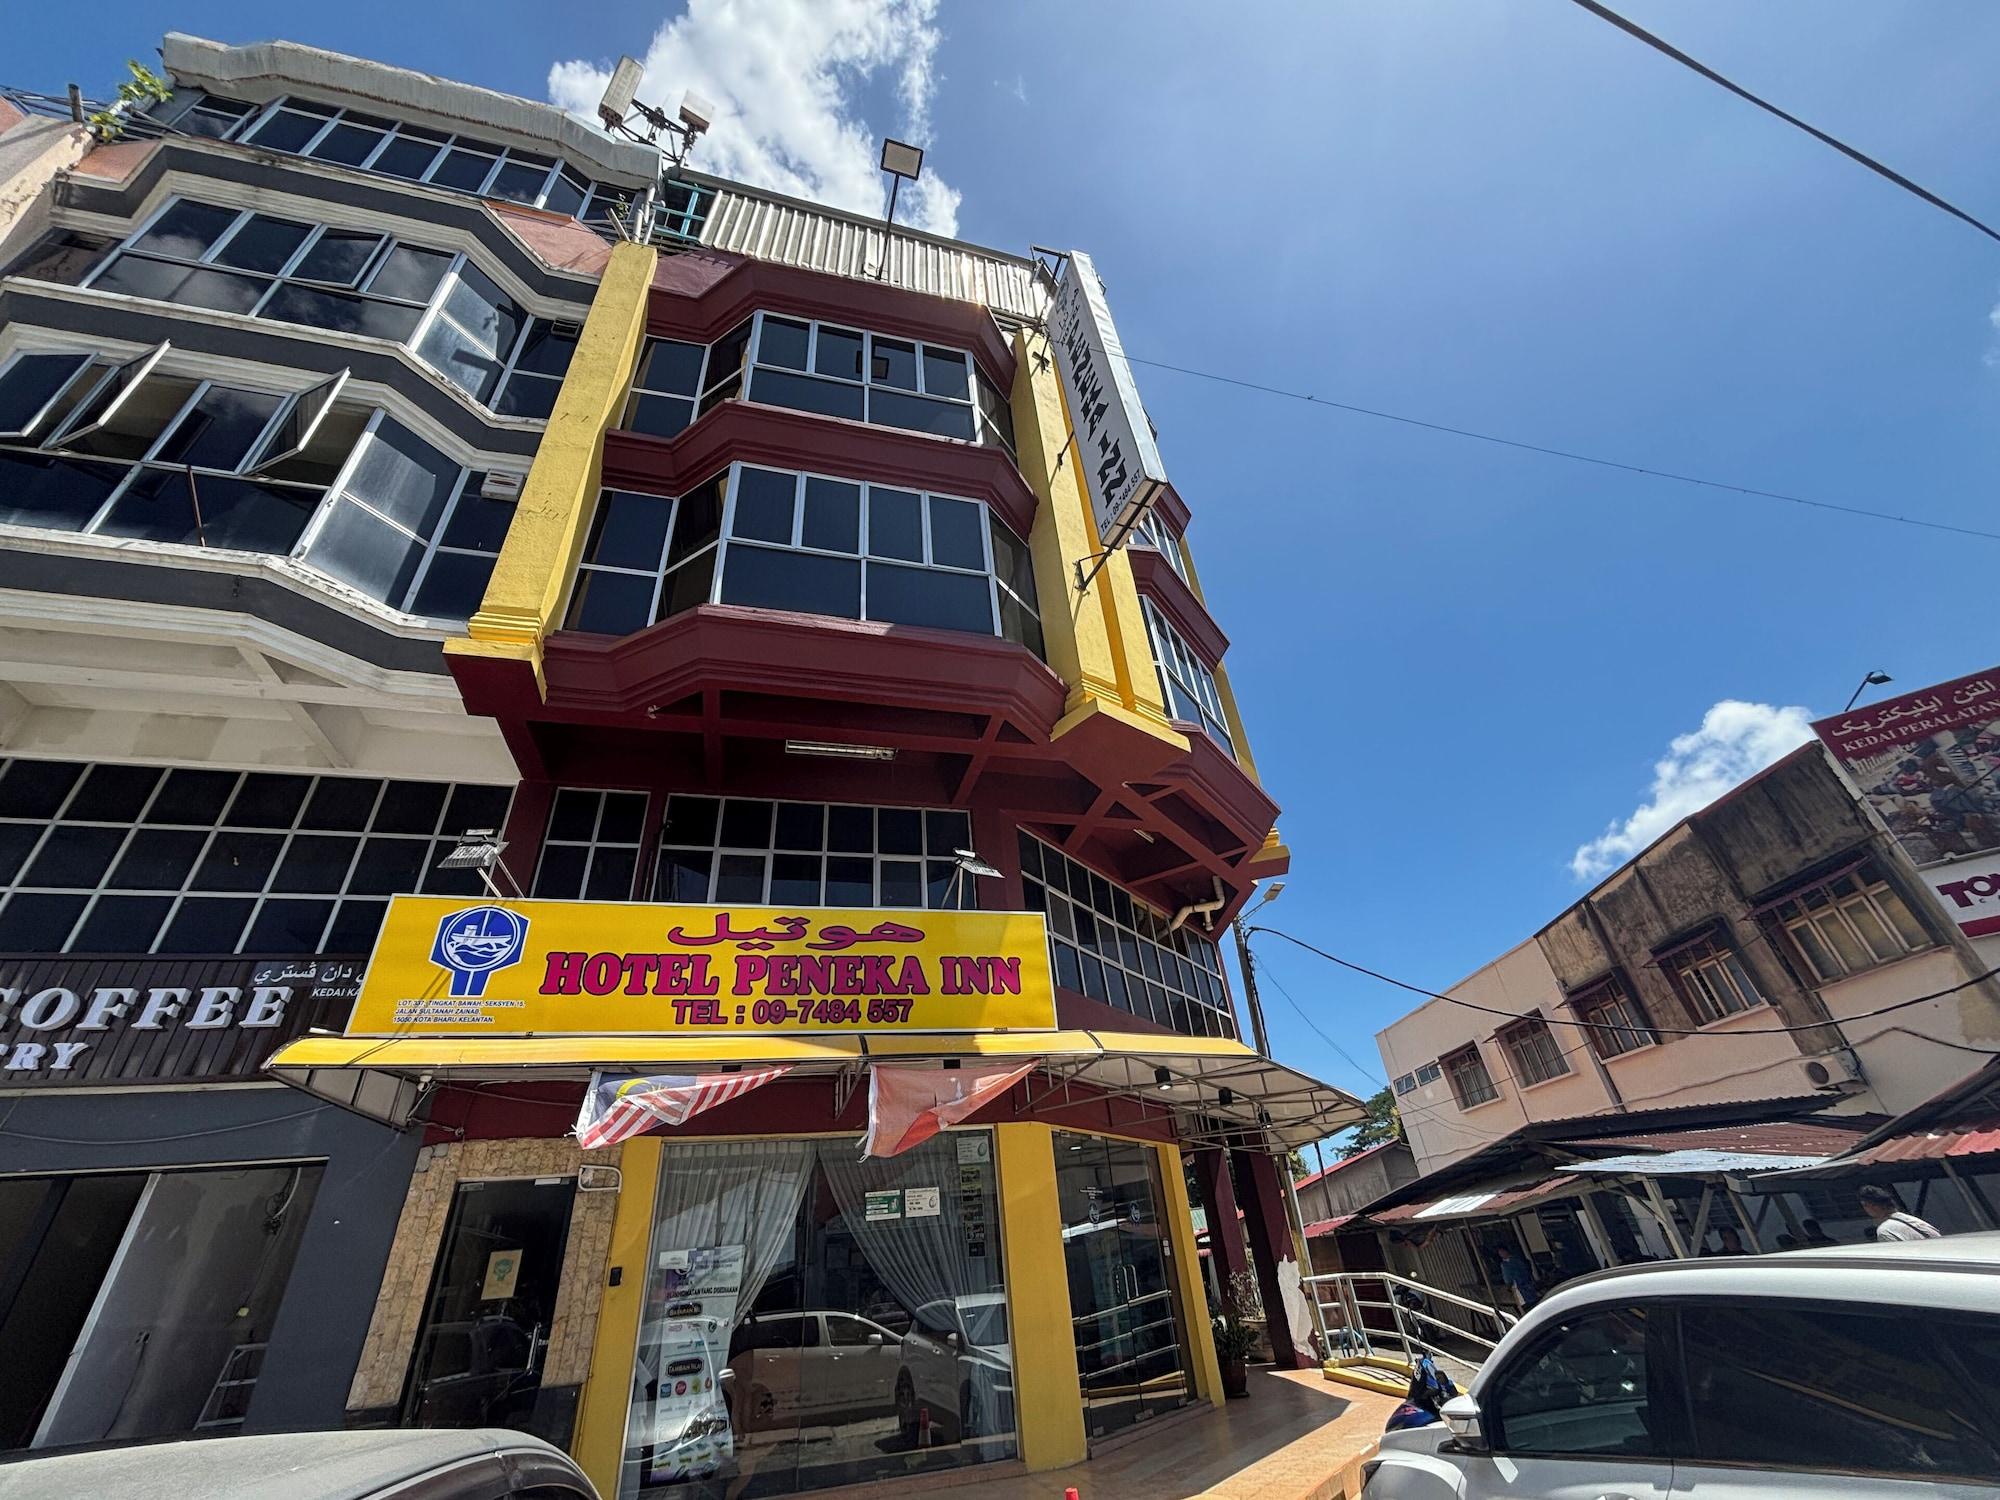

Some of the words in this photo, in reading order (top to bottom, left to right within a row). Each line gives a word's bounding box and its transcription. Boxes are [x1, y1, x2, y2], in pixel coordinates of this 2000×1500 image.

[1066, 318, 1110, 442] PENEKA
[1097, 429, 1127, 509] INN
[1112, 485, 1132, 516] 09-7484
[1130, 468, 1141, 488] 557
[1842, 729, 1897, 752] KEDAI
[667, 911, 926, 952] هوتيل
[312, 987, 345, 997] KEDAI
[538, 951, 720, 996] HOTEL
[732, 954, 931, 996] PENEKA
[939, 956, 1022, 996] INN
[671, 999, 728, 1025] TEL
[752, 999, 861, 1024] 09-7484
[866, 999, 914, 1023] 557
